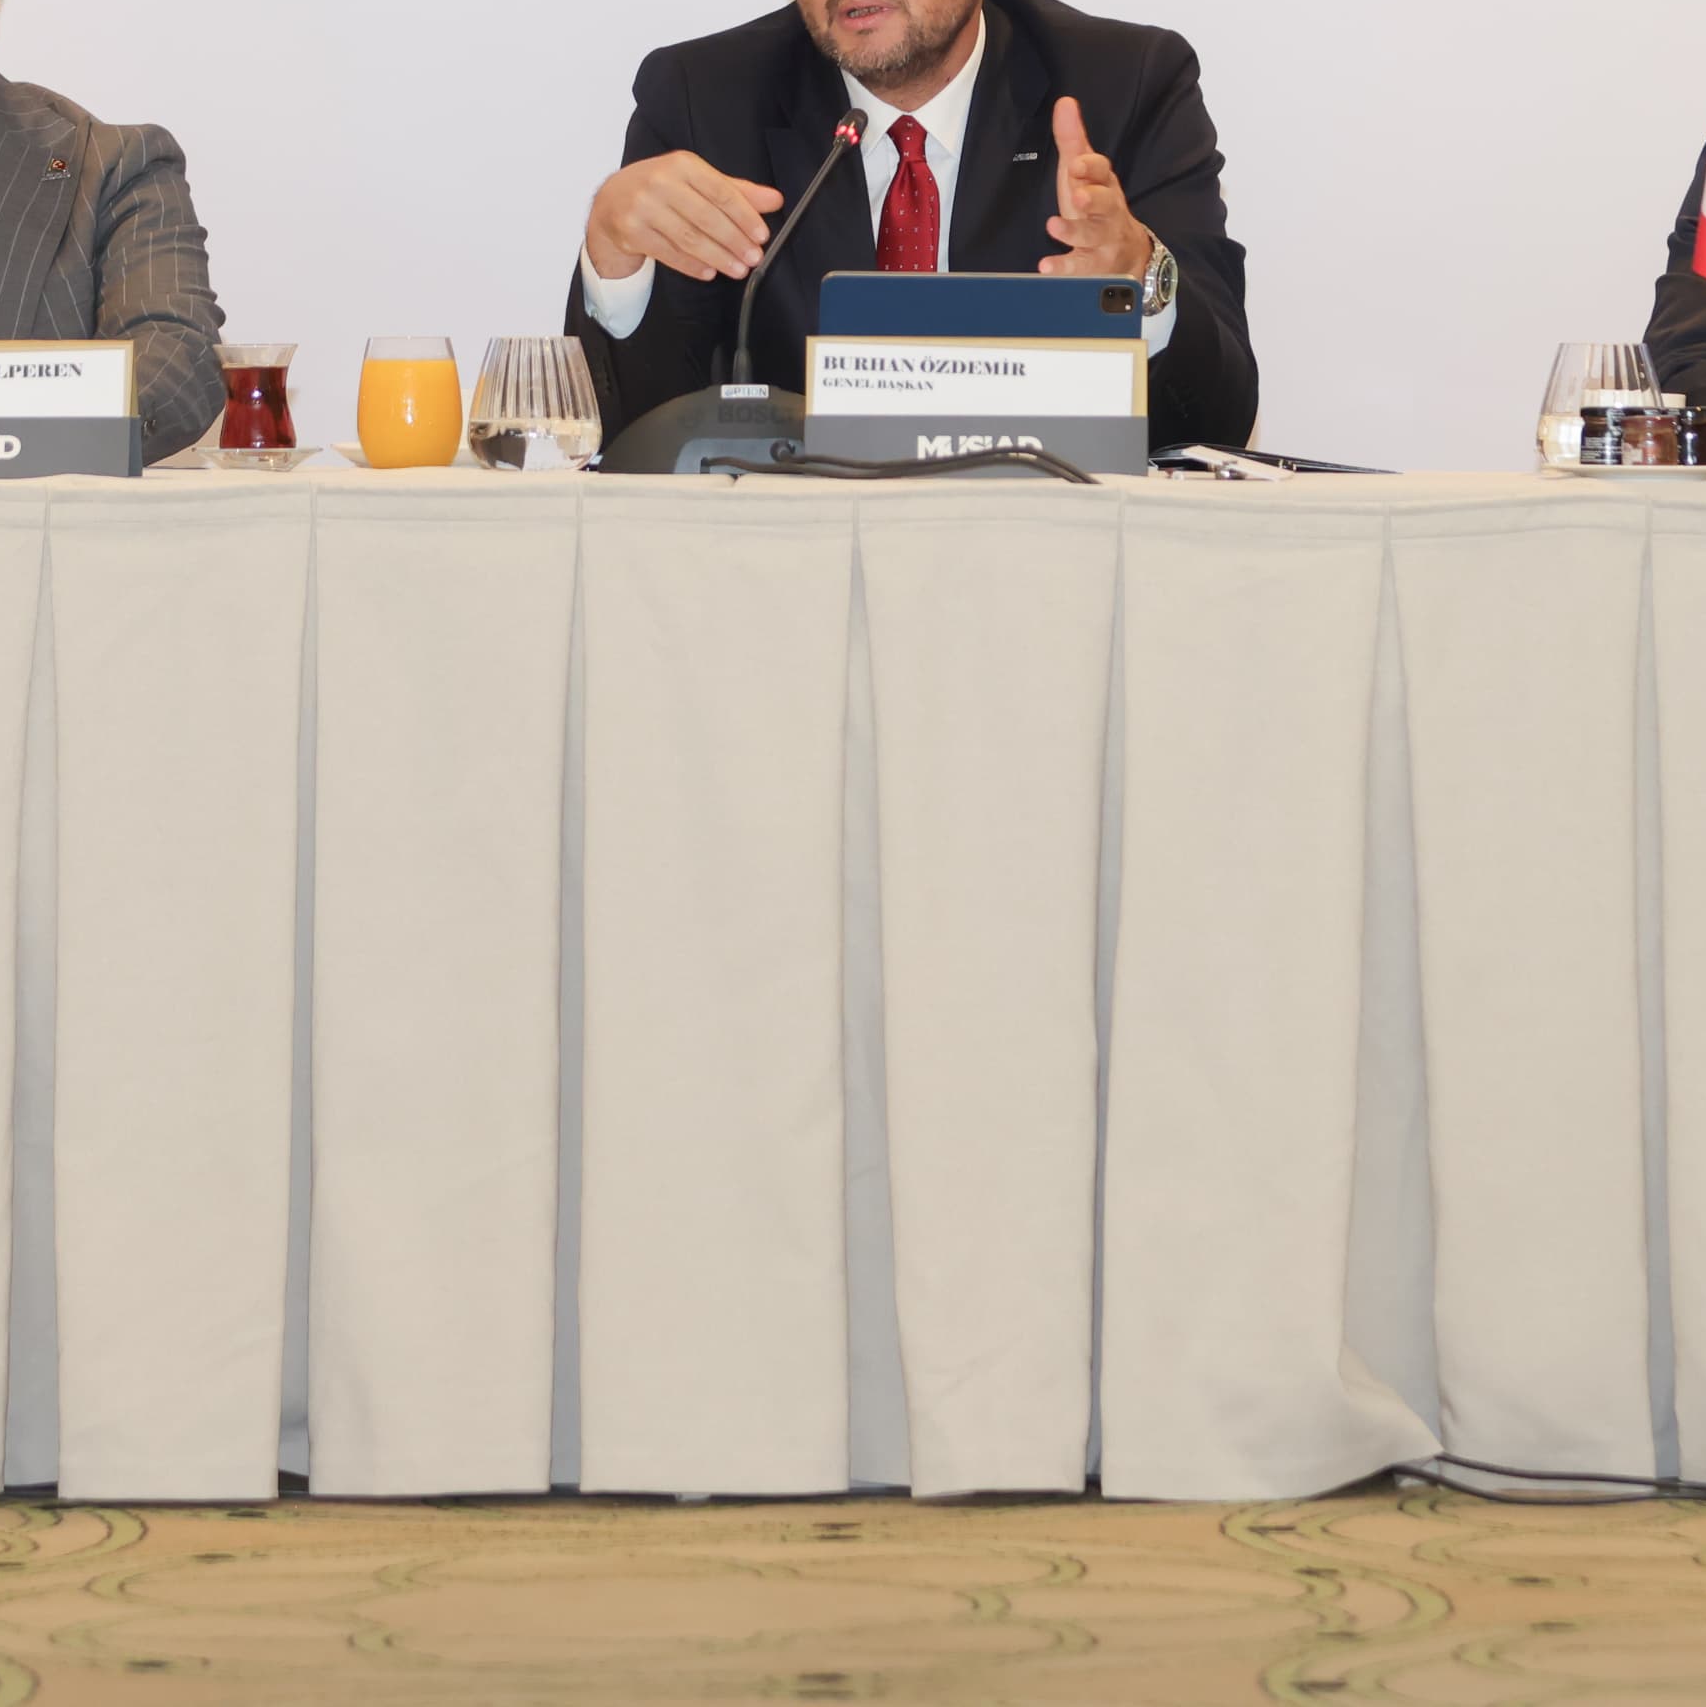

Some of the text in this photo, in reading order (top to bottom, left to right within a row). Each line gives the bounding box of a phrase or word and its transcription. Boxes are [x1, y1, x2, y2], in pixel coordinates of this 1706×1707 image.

[823, 355, 1027, 377] BURHAN ÖZDEMİR
[823, 376, 874, 389] GENEL
